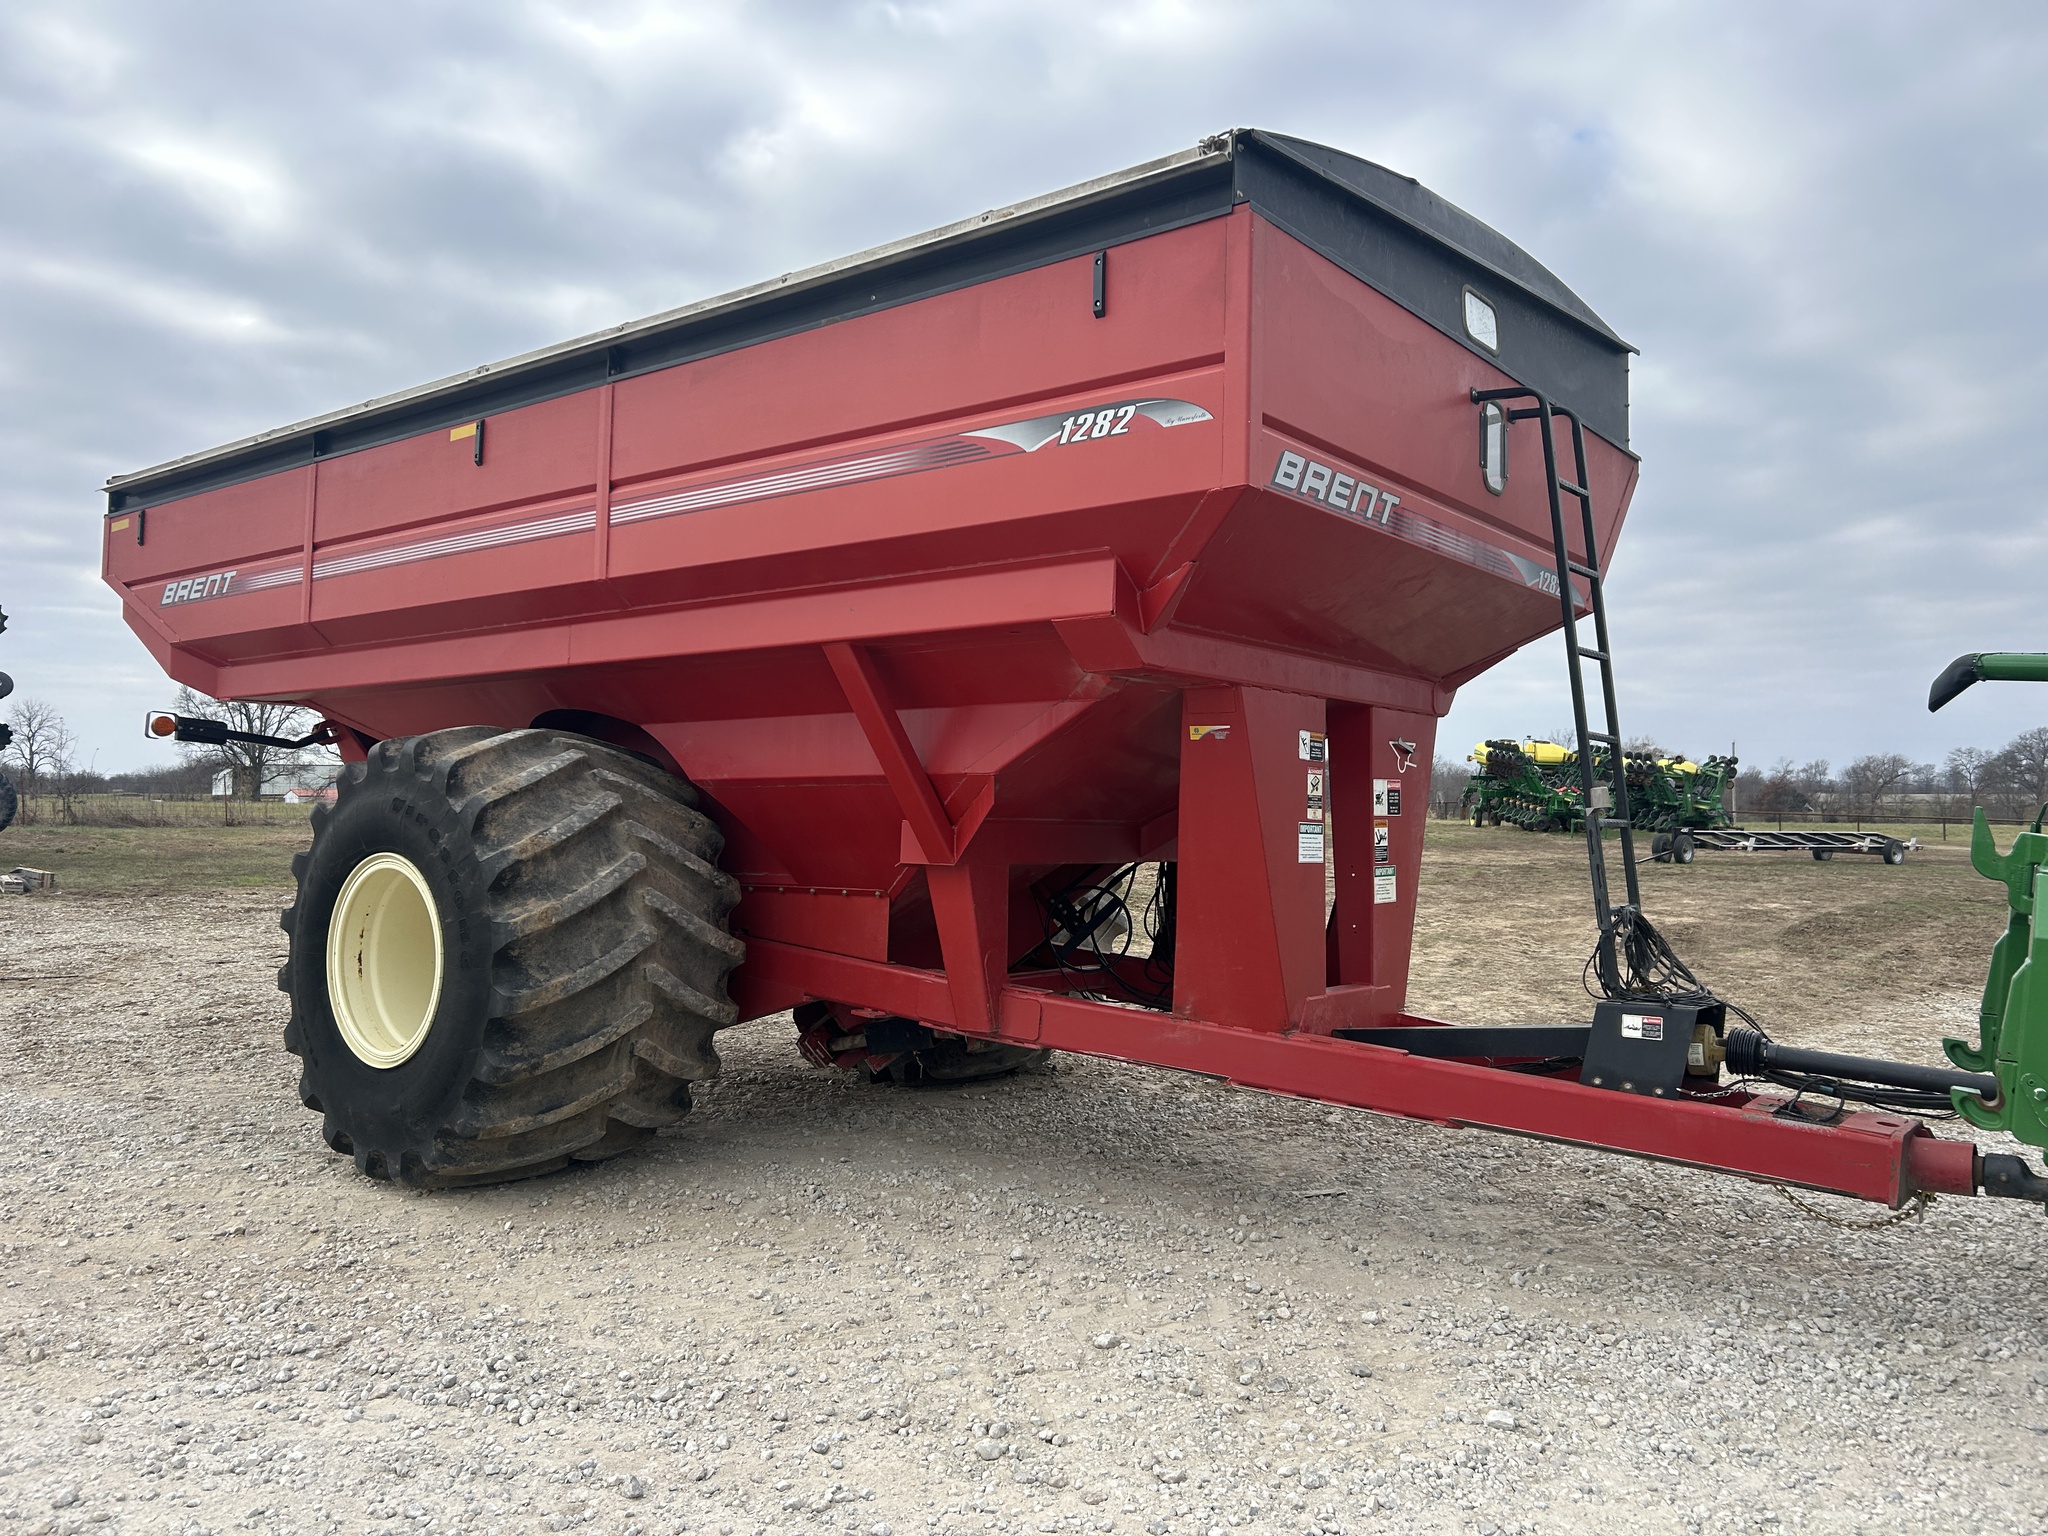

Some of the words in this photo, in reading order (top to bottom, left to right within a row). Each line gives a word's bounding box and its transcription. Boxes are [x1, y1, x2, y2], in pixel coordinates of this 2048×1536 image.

[1058, 405, 1137, 445] 1282
[1273, 450, 1401, 525] BRENT
[161, 570, 238, 605] BRENT
